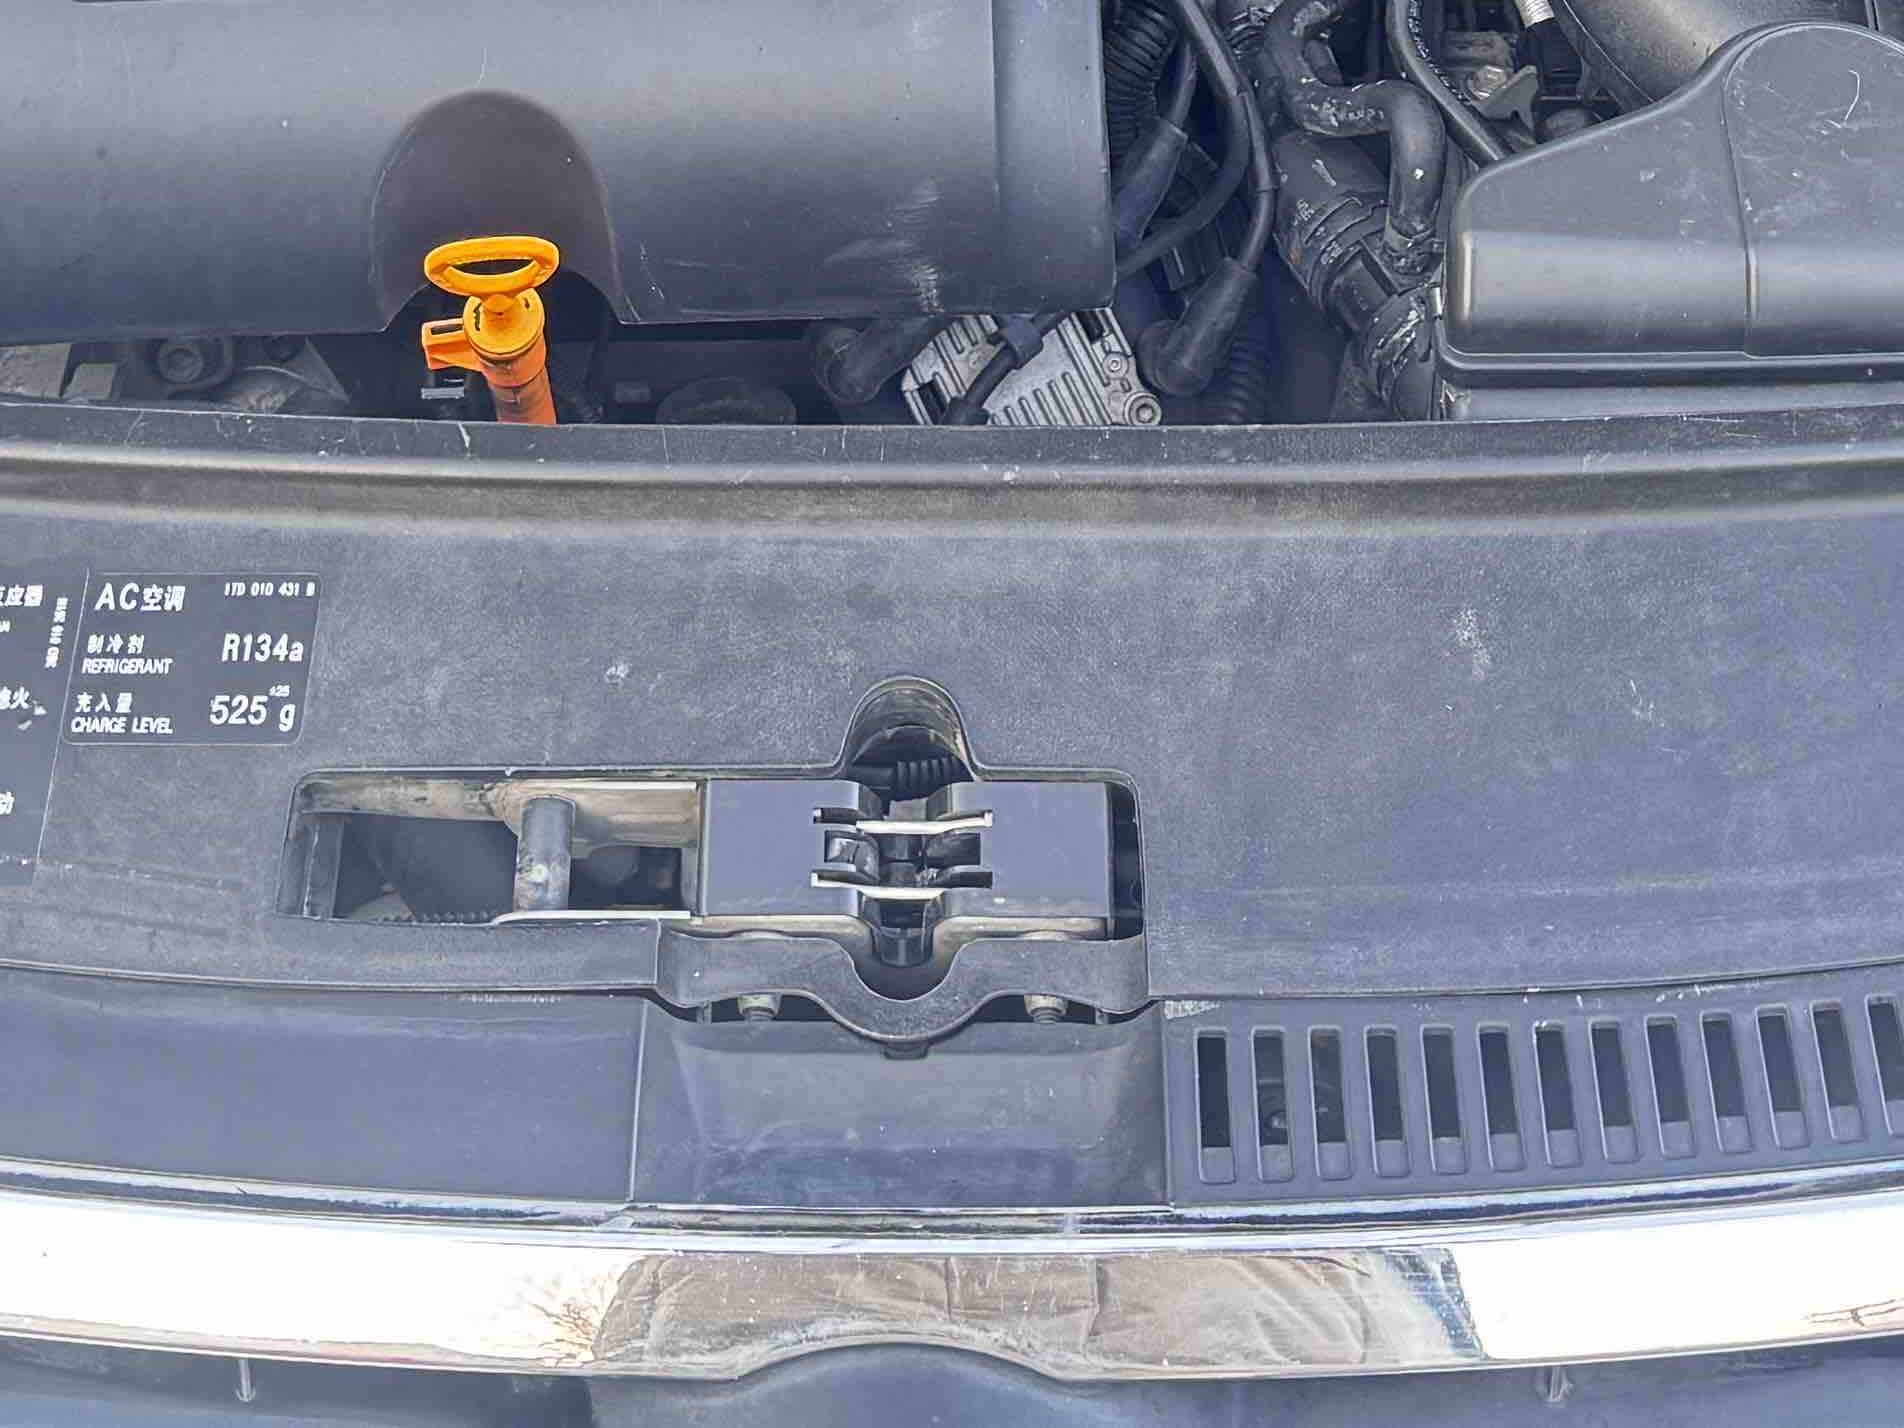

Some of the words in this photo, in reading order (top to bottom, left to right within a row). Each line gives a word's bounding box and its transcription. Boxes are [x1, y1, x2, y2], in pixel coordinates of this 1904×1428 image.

[250, 581, 274, 597] 010
[221, 632, 304, 662] R134a
[81, 657, 174, 675] REFRIGERANT
[209, 695, 269, 726] 525
[278, 703, 296, 732] g
[70, 716, 126, 734] CHARGE
[131, 716, 174, 734] LEVEL
